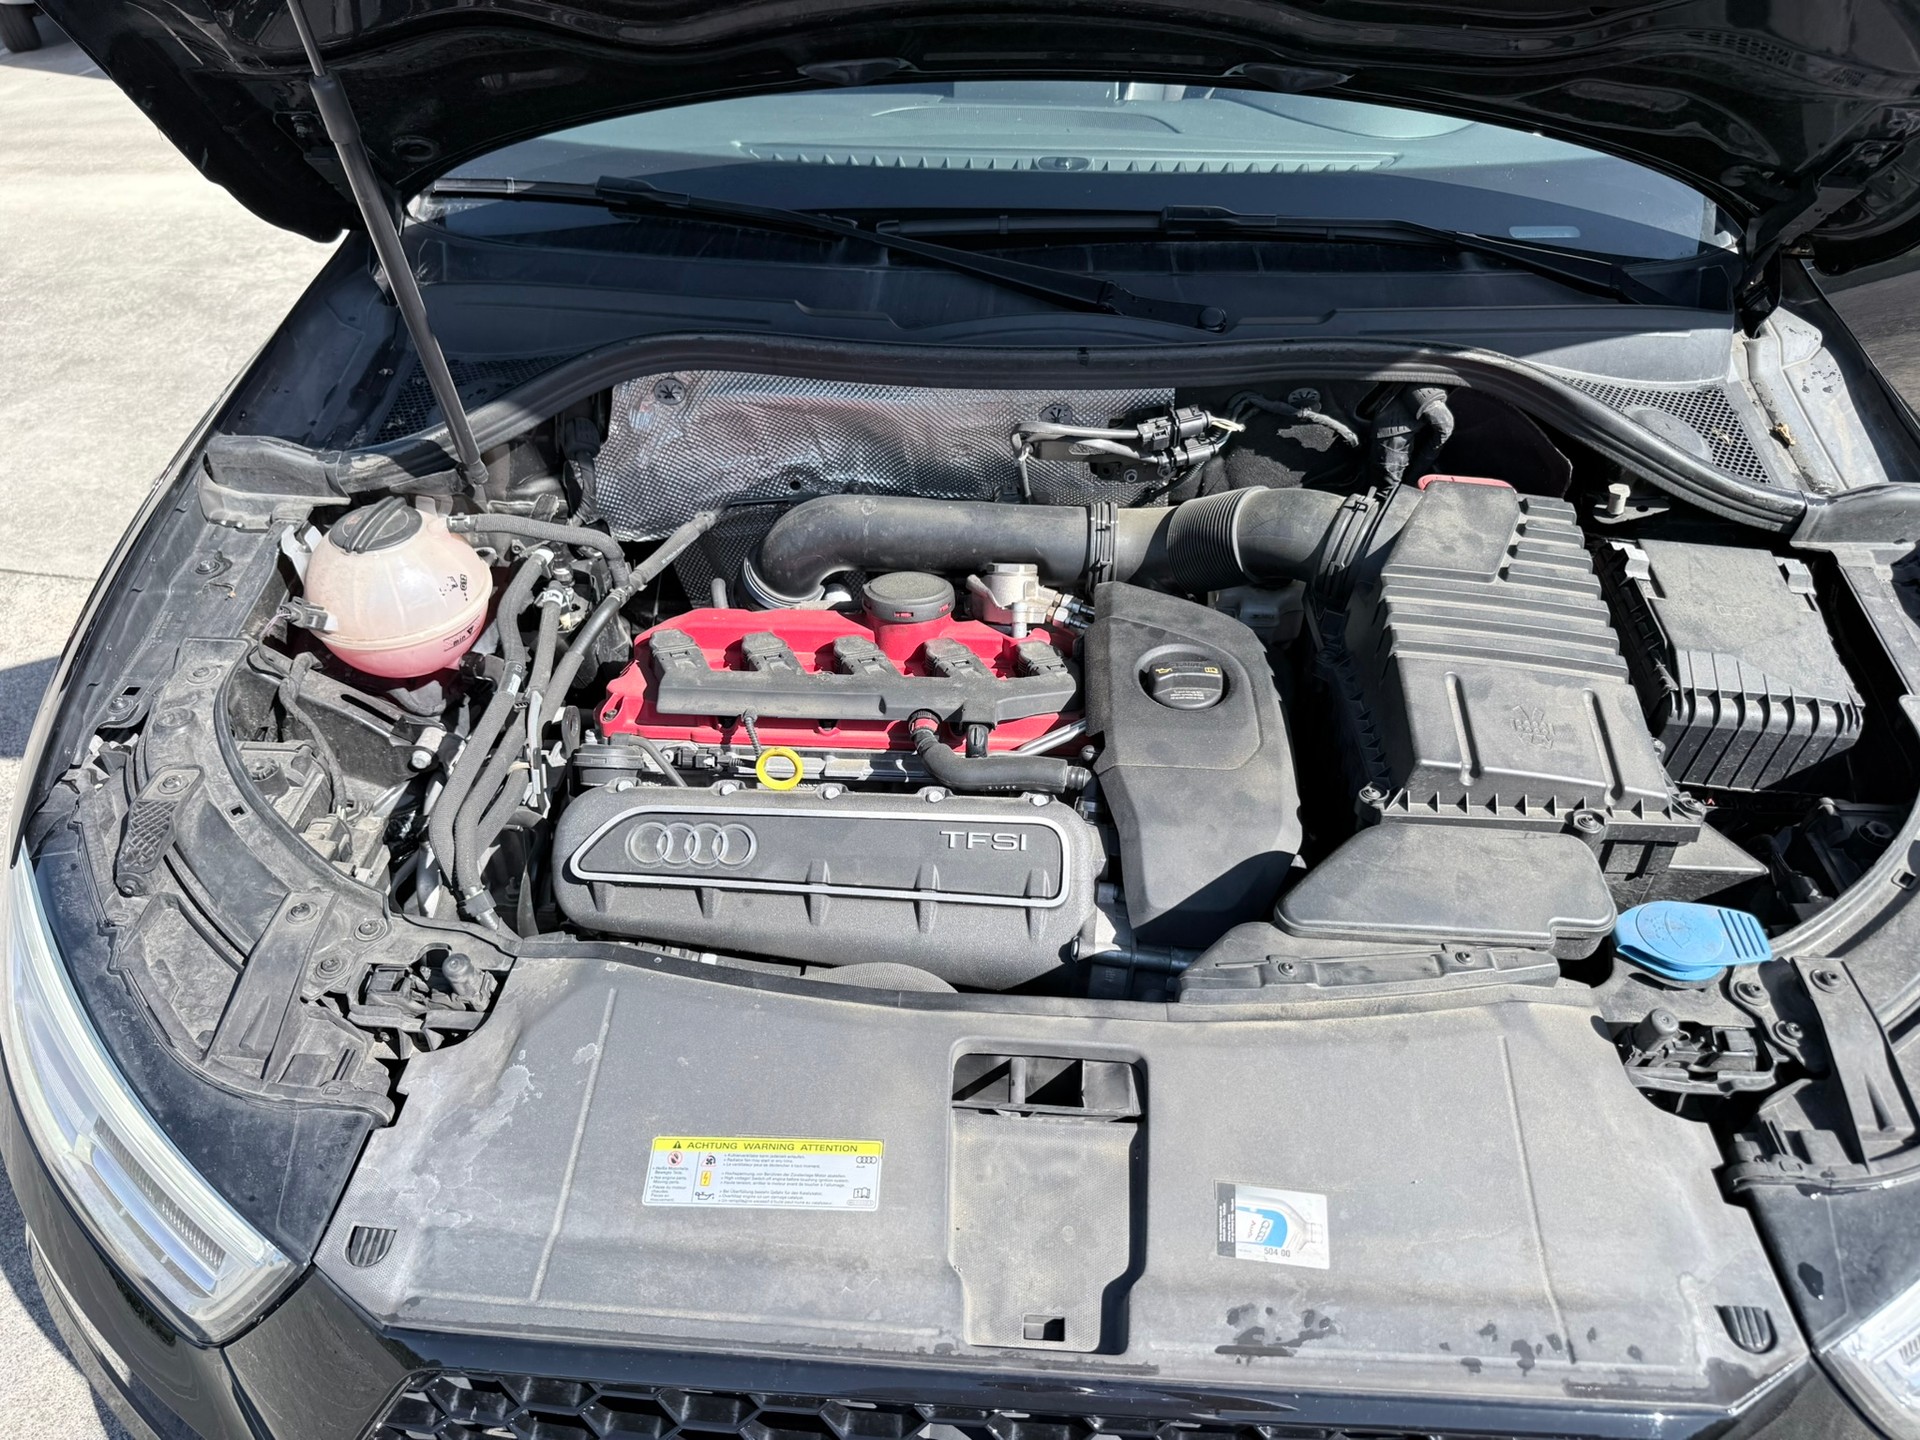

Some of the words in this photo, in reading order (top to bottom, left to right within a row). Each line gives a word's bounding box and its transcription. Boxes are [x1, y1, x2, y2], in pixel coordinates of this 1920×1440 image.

[453, 635, 466, 647] min
[939, 830, 1027, 851] TFSI
[687, 1142, 738, 1150] ACHTUNG
[743, 1142, 795, 1151] WARNING
[800, 1143, 858, 1152] ATTENTION
[1264, 1246, 1278, 1256] 504
[1281, 1248, 1291, 1258] 00
